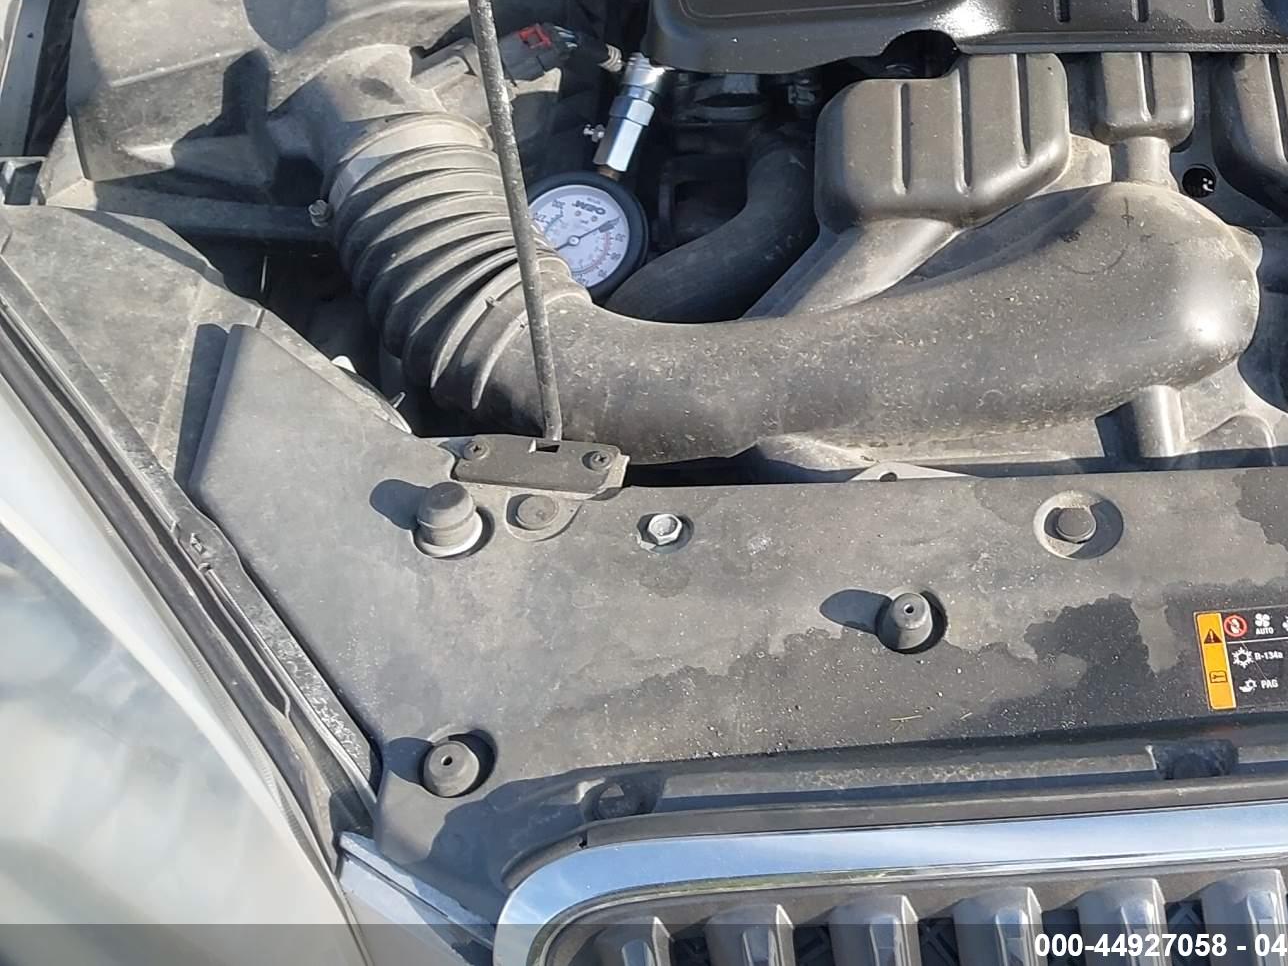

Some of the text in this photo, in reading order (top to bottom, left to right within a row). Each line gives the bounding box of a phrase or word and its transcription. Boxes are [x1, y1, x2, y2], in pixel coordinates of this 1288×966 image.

[1255, 626, 1274, 635] AUTO
[1254, 650, 1283, 660] R-134a
[1260, 679, 1279, 689] PAG
